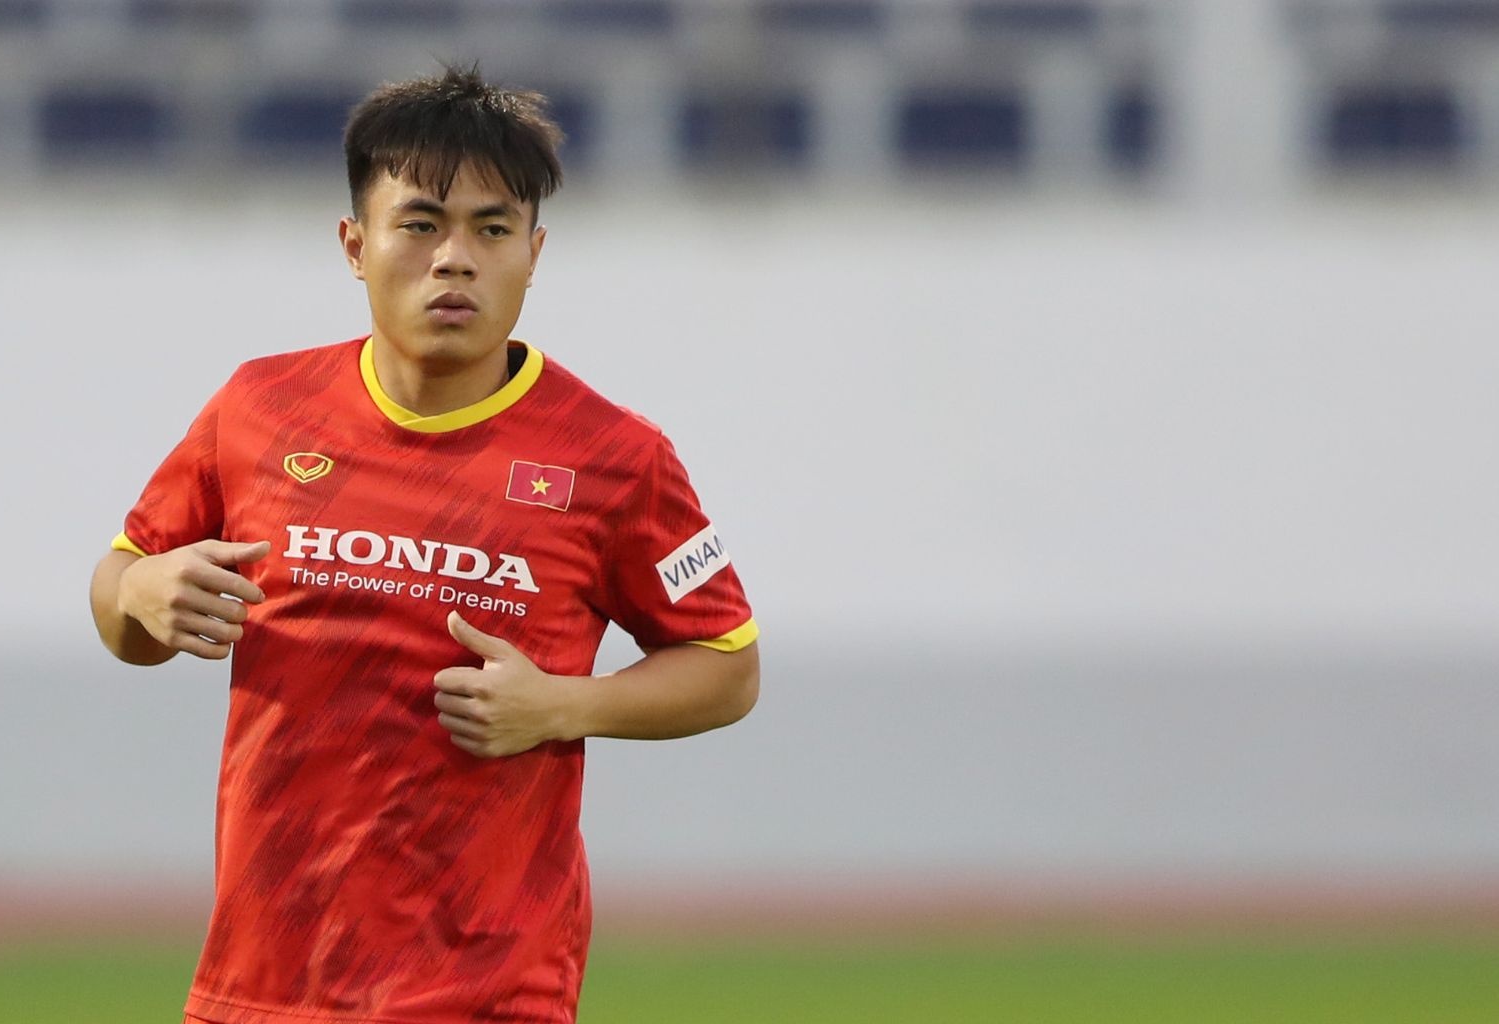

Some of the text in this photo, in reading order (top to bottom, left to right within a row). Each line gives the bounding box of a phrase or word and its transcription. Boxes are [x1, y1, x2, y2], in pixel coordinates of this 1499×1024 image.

[283, 525, 540, 593] HONDA
[290, 567, 527, 617] The Power of Dreams
